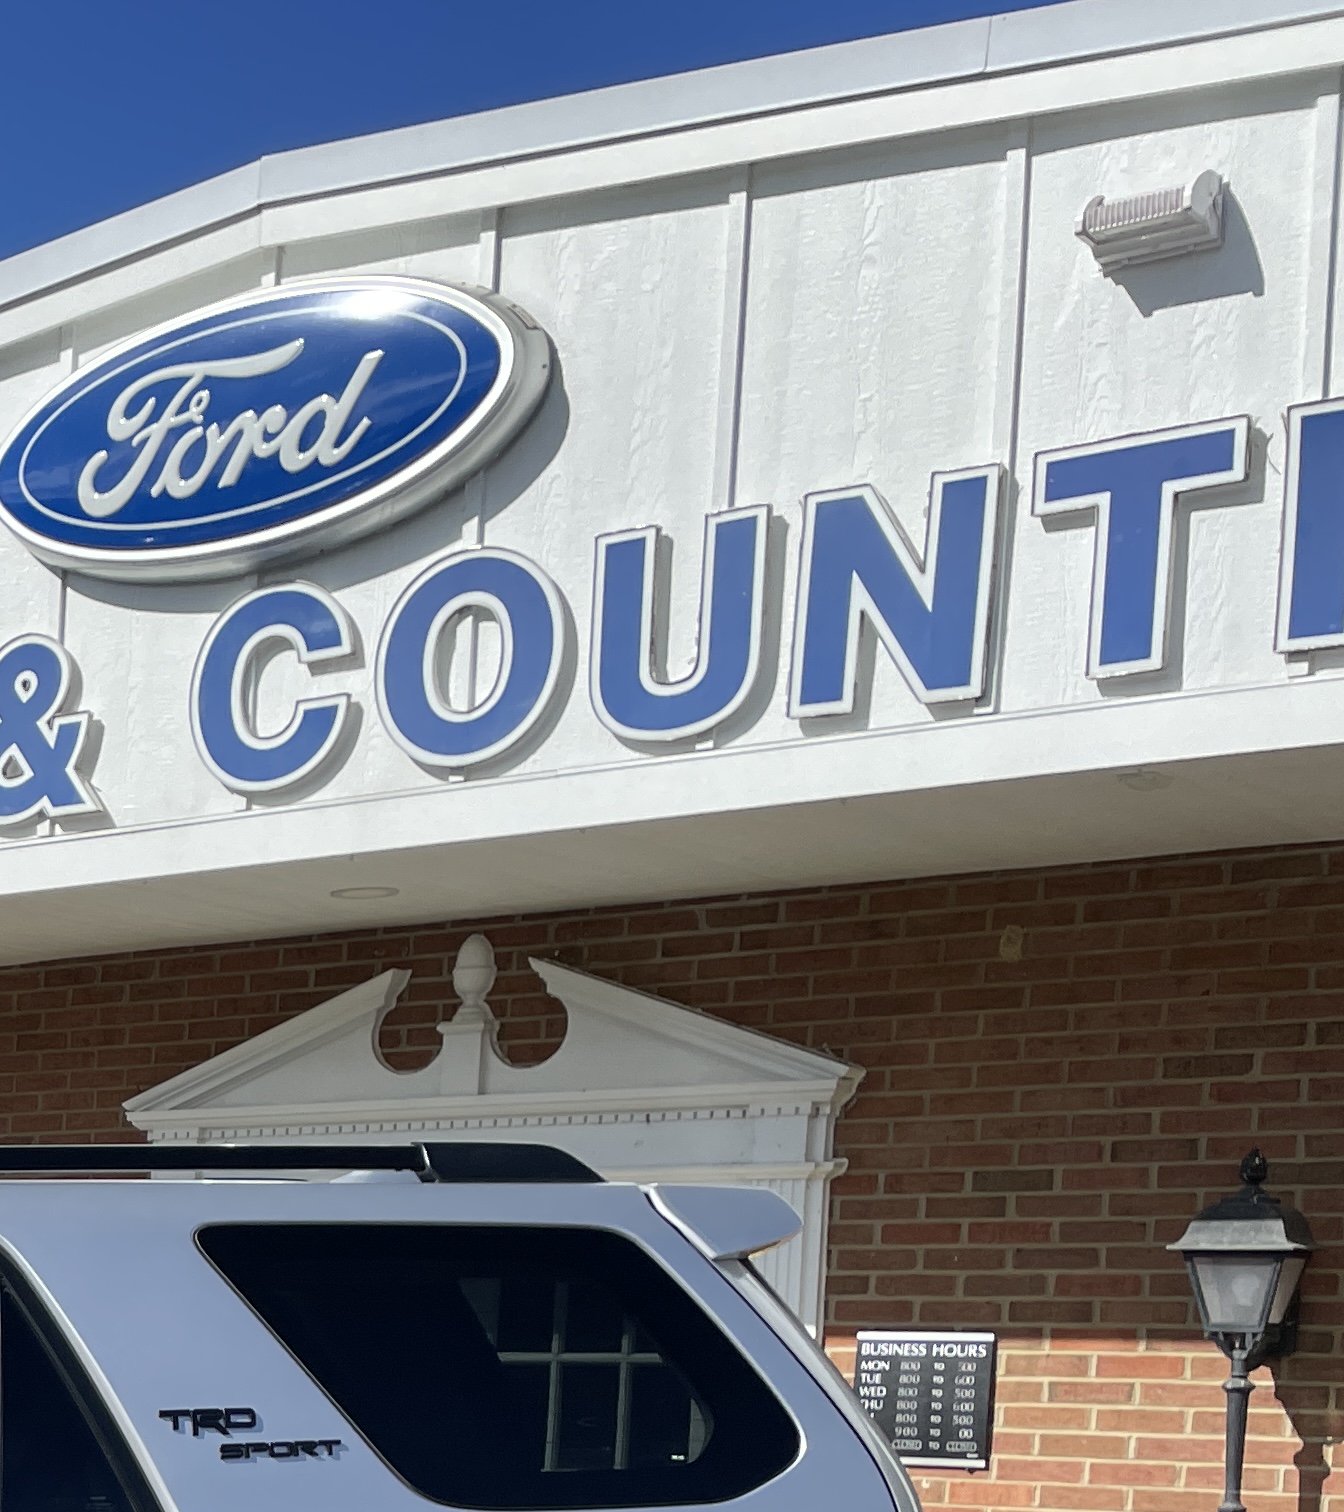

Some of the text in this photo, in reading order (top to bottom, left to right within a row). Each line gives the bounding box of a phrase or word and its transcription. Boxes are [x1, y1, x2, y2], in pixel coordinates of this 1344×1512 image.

[79, 337, 385, 516] Ford
[861, 1342, 987, 1358] BUSINESS HOURS
[860, 1360, 891, 1371] MON
[933, 1362, 945, 1371] TO
[860, 1372, 882, 1384] TUE
[932, 1375, 944, 1385] TO
[859, 1385, 887, 1398] WED
[931, 1388, 943, 1398] TO
[860, 1399, 884, 1410] THU
[931, 1401, 943, 1411] TO
[159, 1407, 257, 1437] TRD
[930, 1414, 942, 1425] TO
[929, 1428, 941, 1438] TO
[219, 1439, 342, 1460] SPORT
[928, 1441, 940, 1451] TO
